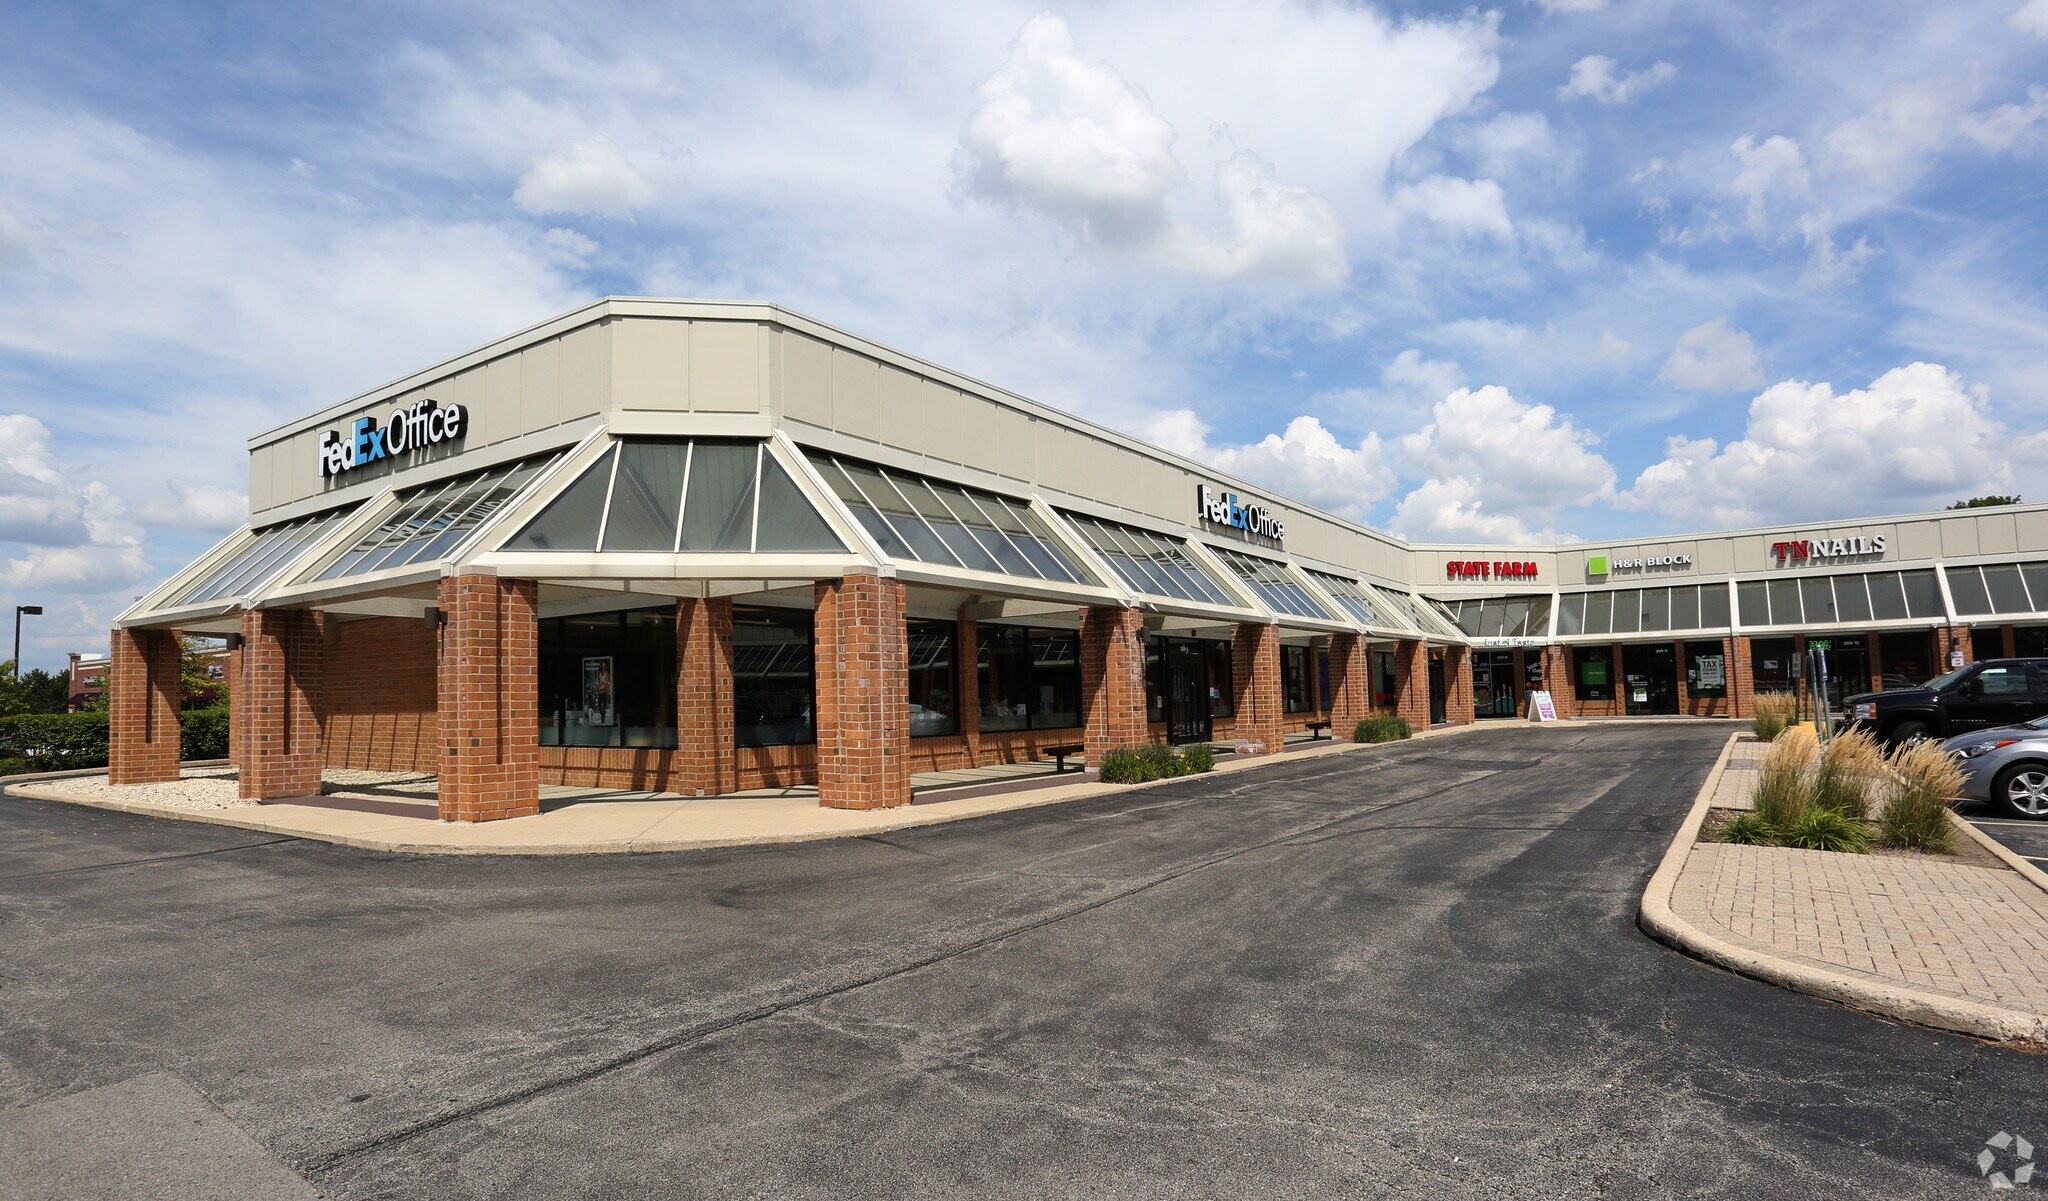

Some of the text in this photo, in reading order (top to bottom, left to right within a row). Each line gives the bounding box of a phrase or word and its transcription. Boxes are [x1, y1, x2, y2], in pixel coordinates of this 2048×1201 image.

[318, 399, 461, 478] FedEx Office
[1200, 483, 1285, 541] FedEx Office
[1811, 534, 1887, 558] NAILS
[1446, 560, 1539, 577] STATE FARM
[1613, 554, 1692, 570] H&R BLOCK
[1702, 660, 1717, 668] TAX
